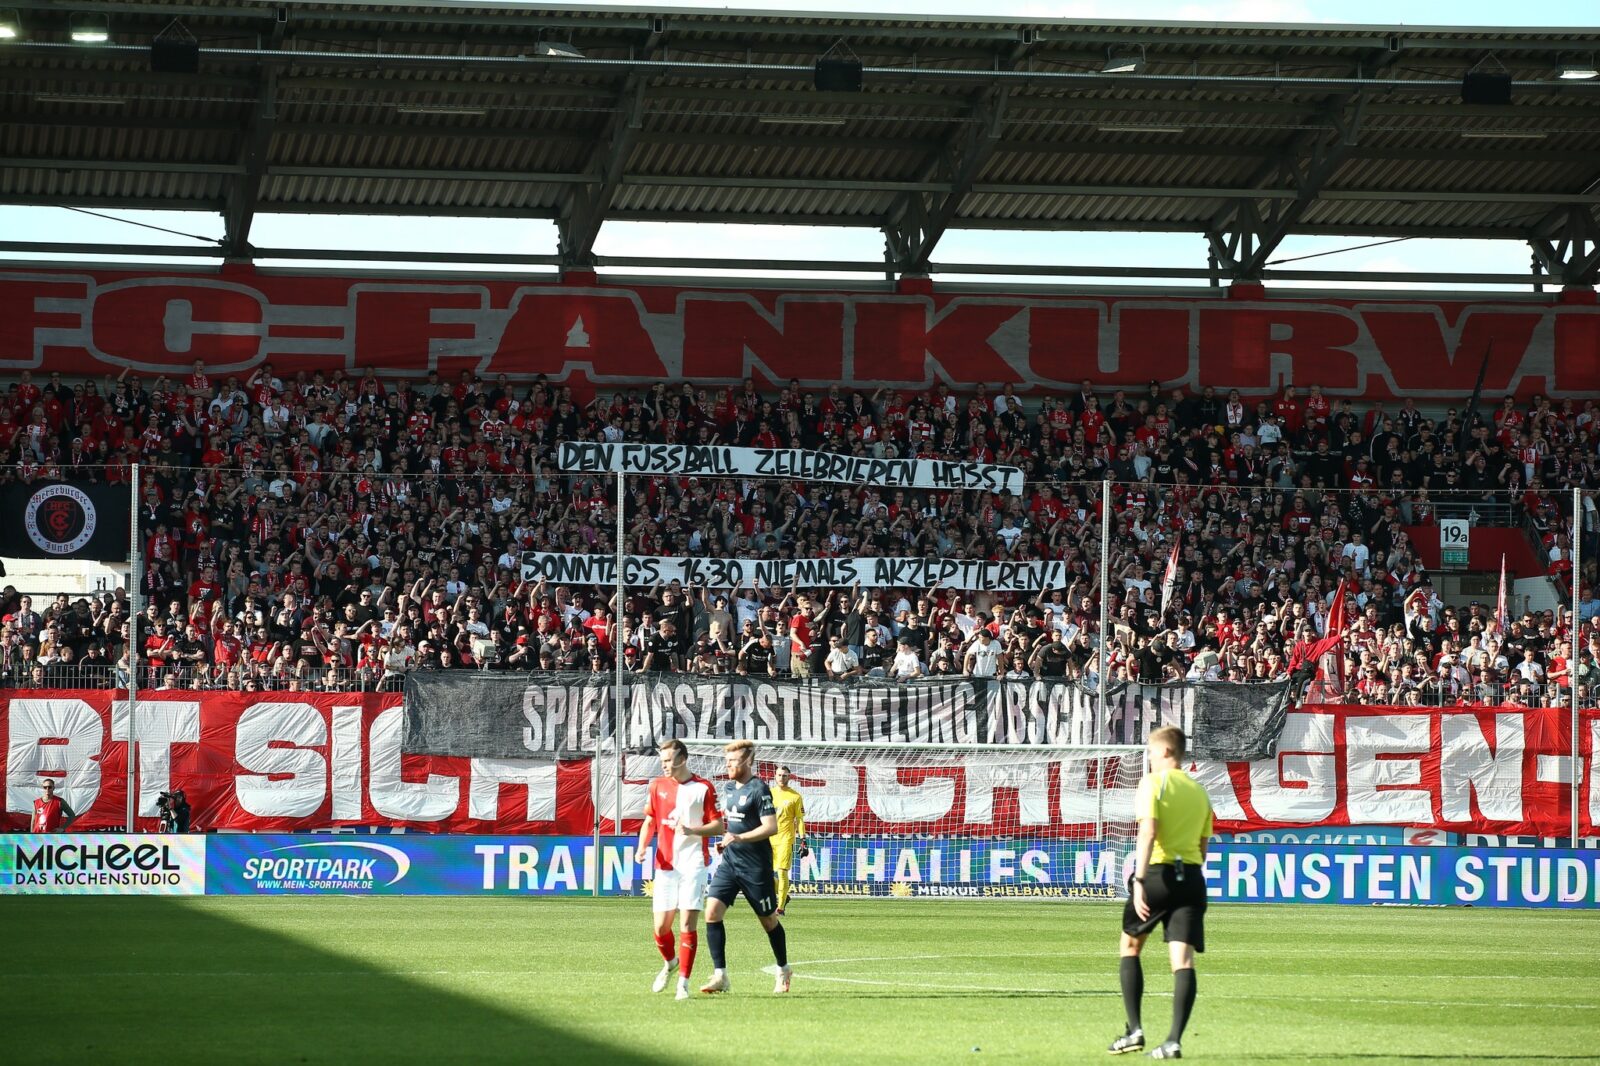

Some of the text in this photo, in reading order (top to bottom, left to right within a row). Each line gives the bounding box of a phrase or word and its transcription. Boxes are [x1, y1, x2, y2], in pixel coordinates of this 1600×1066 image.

[562, 442, 1019, 495] DEN FUSSBALL ZELEBRIEREN HEISST
[31, 485, 89, 504] Merseburger
[1442, 526, 1468, 543] 19a
[45, 541, 74, 553] Jungs
[524, 550, 1061, 592] SONNTAGS 16:30 NIEMALS AKZEPTIEREN!
[243, 858, 377, 880] SPORTPARK
[16, 871, 180, 885] DAS KÜCHENSTUDIO
[257, 880, 373, 889] WWW.MEIN-SPORTPARK.DE
[824, 883, 870, 894] HALLE
[918, 885, 1115, 897] MERKUR SPIELBANK HALLE
[759, 896, 772, 912] 11
